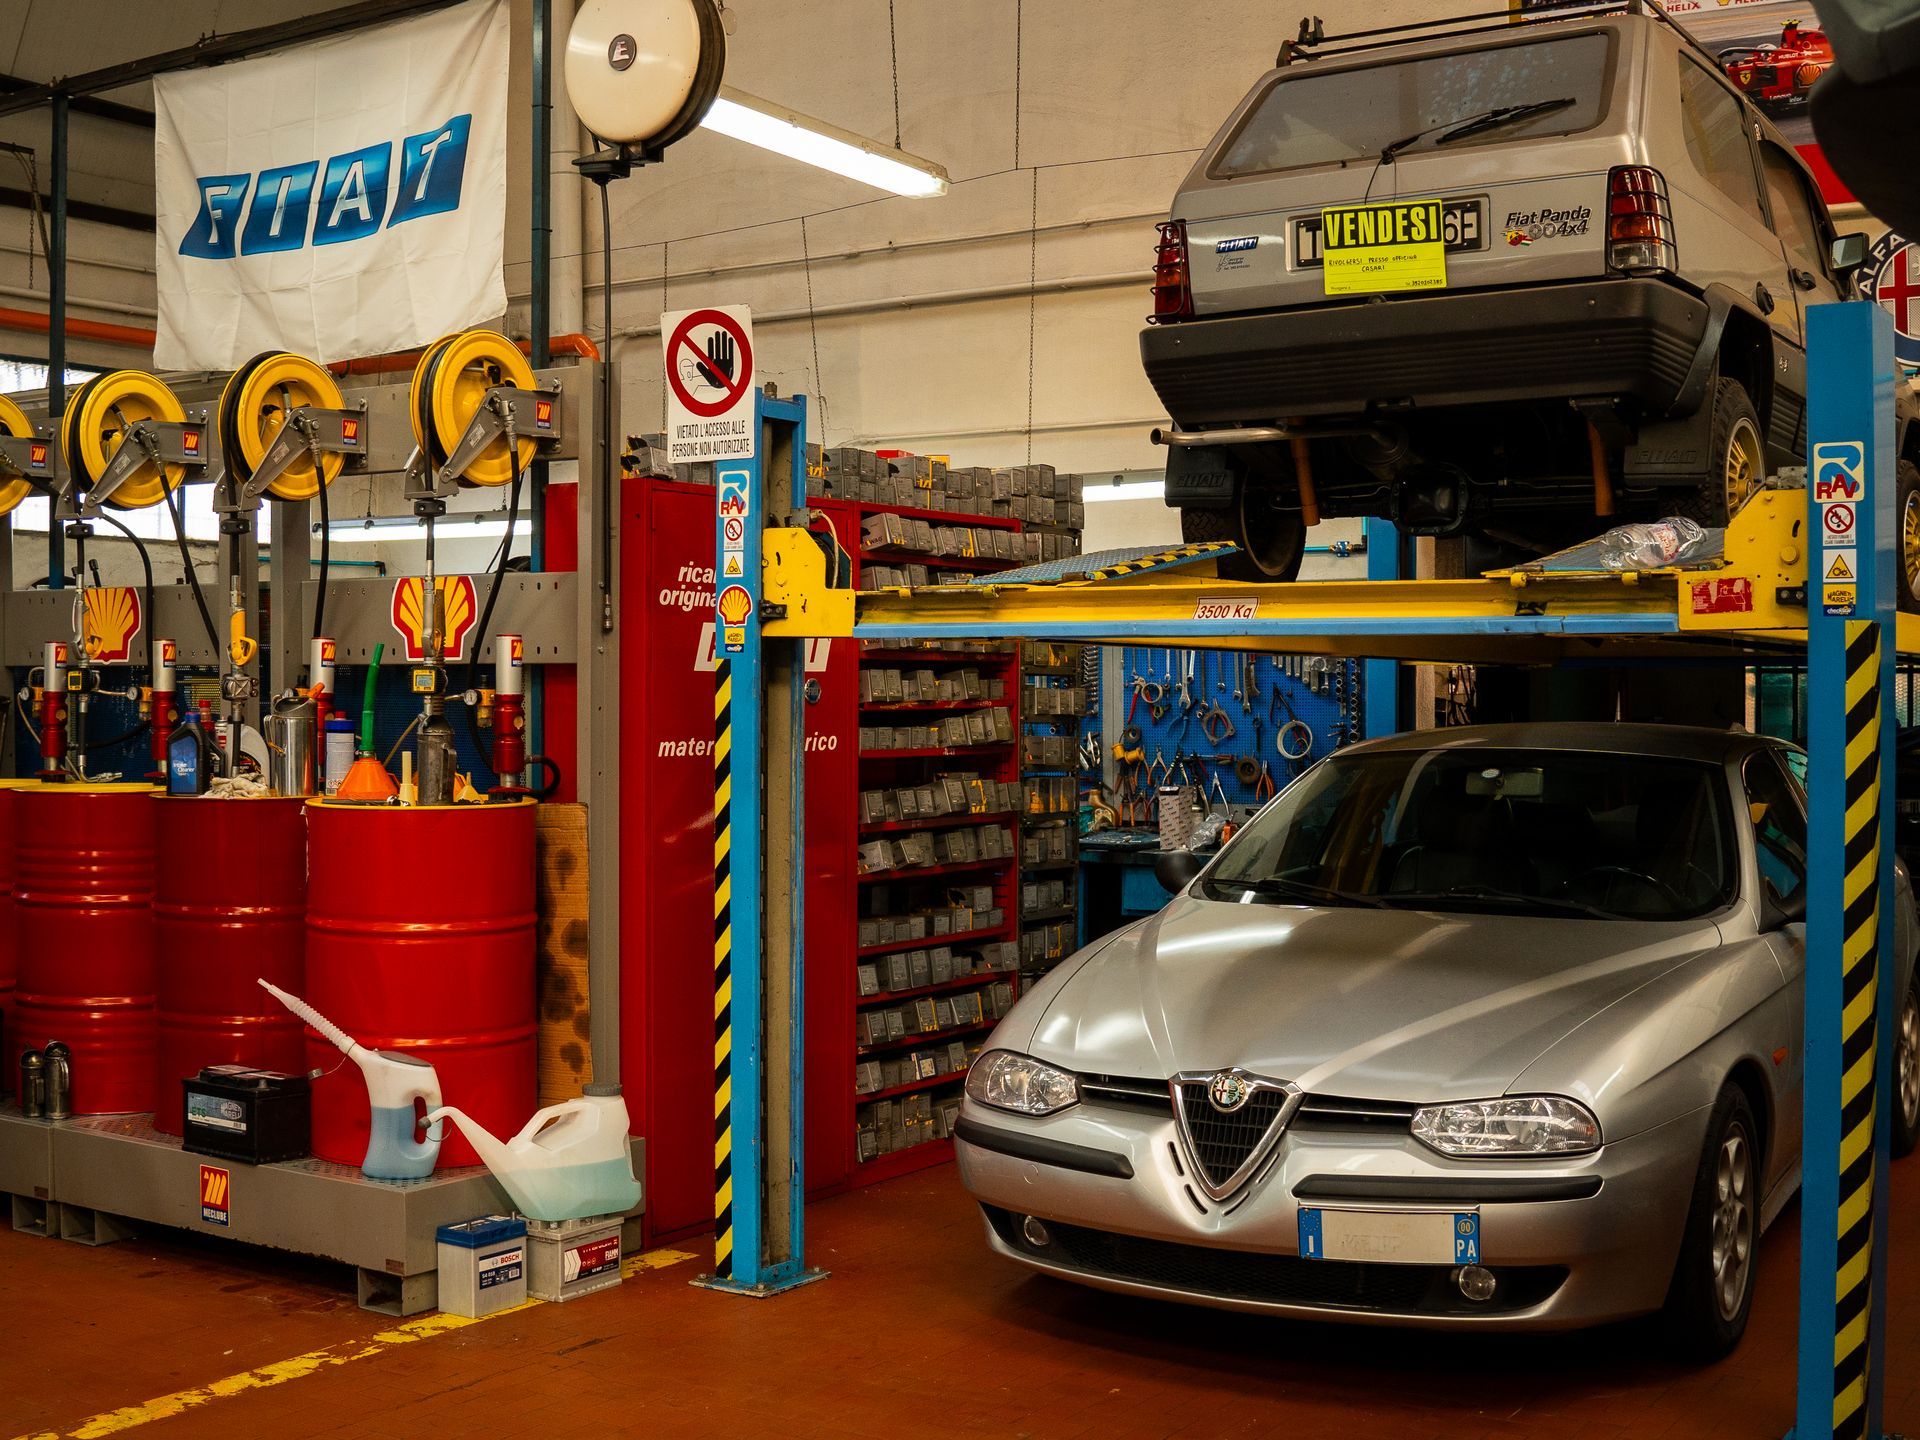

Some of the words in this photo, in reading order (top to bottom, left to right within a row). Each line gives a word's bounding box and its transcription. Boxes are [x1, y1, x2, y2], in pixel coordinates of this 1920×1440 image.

[1667, 2, 1701, 13] HELIX
[203, 129, 453, 235] FIAT
[1325, 206, 1438, 246] VENDESI
[1505, 212, 1537, 228] Fiat
[1540, 206, 1592, 224] Panda
[1557, 220, 1589, 236] 4x4
[1216, 237, 1259, 253] FIAT
[1306, 226, 1322, 258] T
[1859, 233, 1906, 295] ALFA
[677, 424, 699, 439] VIETATO
[700, 421, 731, 437] L'ACCESSO
[732, 420, 745, 435] ALLE
[672, 443, 698, 457] PERSONE
[699, 441, 712, 455] NON
[713, 438, 750, 455] AUTORIZZATE
[1816, 473, 1858, 499] RAV
[720, 495, 745, 515] RAV
[1197, 605, 1230, 619] 3500
[658, 737, 715, 757] mater
[804, 731, 838, 752] rico
[203, 1207, 227, 1222] MECLUBE
[1308, 1235, 1315, 1253] I
[1456, 1239, 1476, 1258] PA
[501, 1254, 520, 1264] BOSCH
